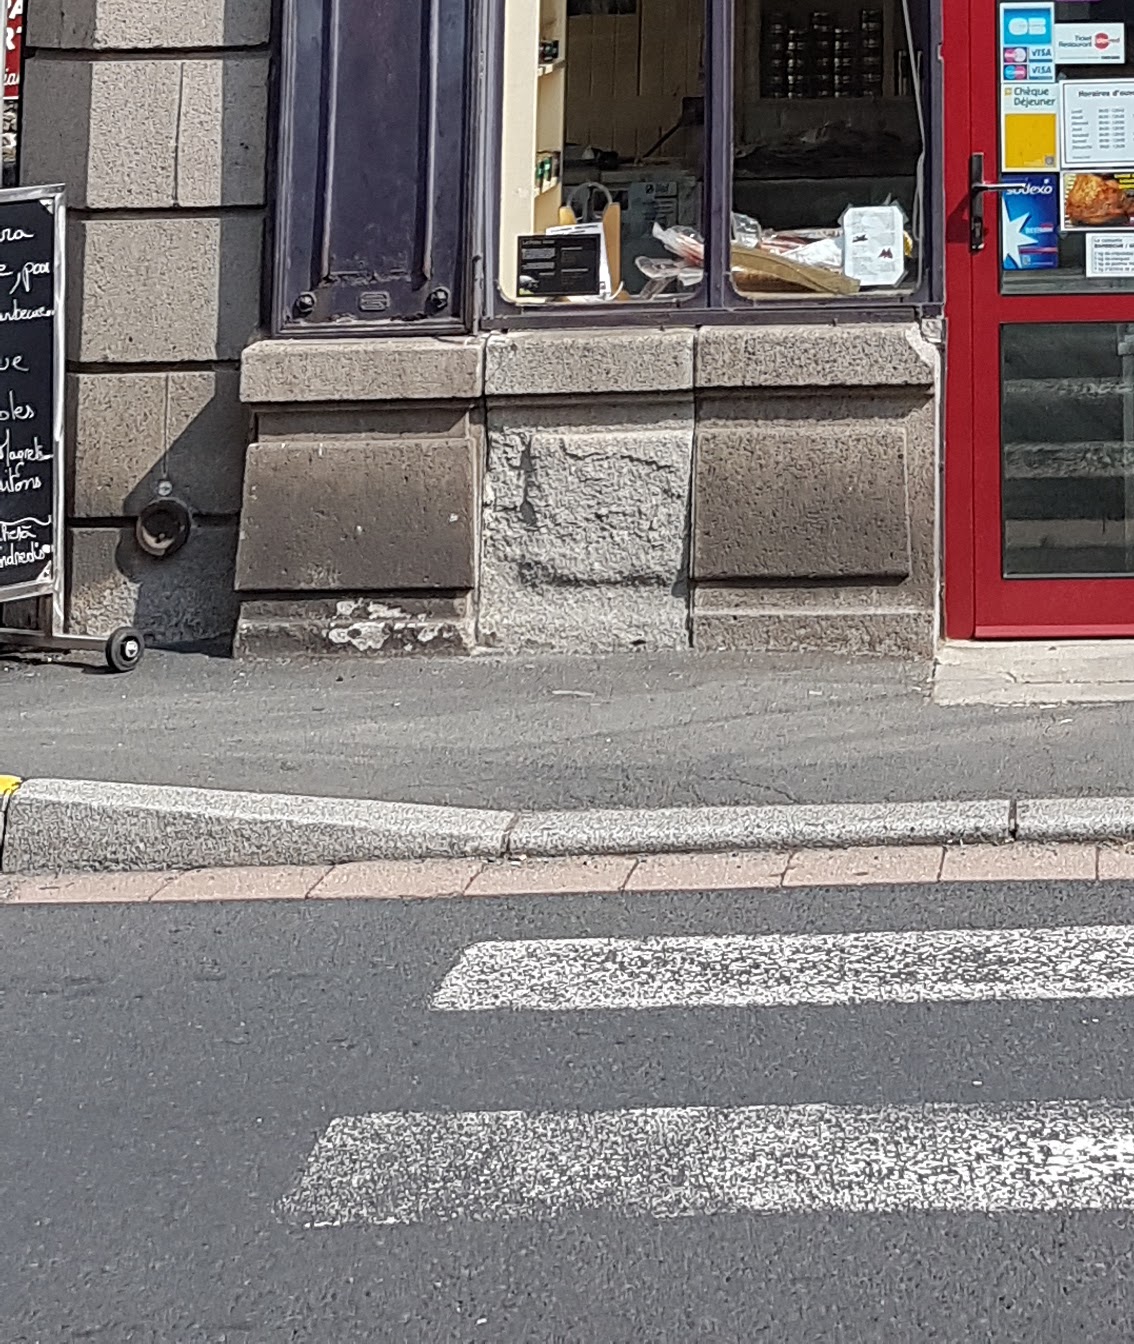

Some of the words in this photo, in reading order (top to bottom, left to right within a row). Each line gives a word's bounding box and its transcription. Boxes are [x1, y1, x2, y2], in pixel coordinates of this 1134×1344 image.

[1032, 48, 1052, 56] VISA
[1032, 66, 1052, 74] VISA
[1014, 87, 1049, 97] Chèque
[1078, 90, 1110, 98] Horaires
[1014, 98, 1056, 108] Déjeuner
